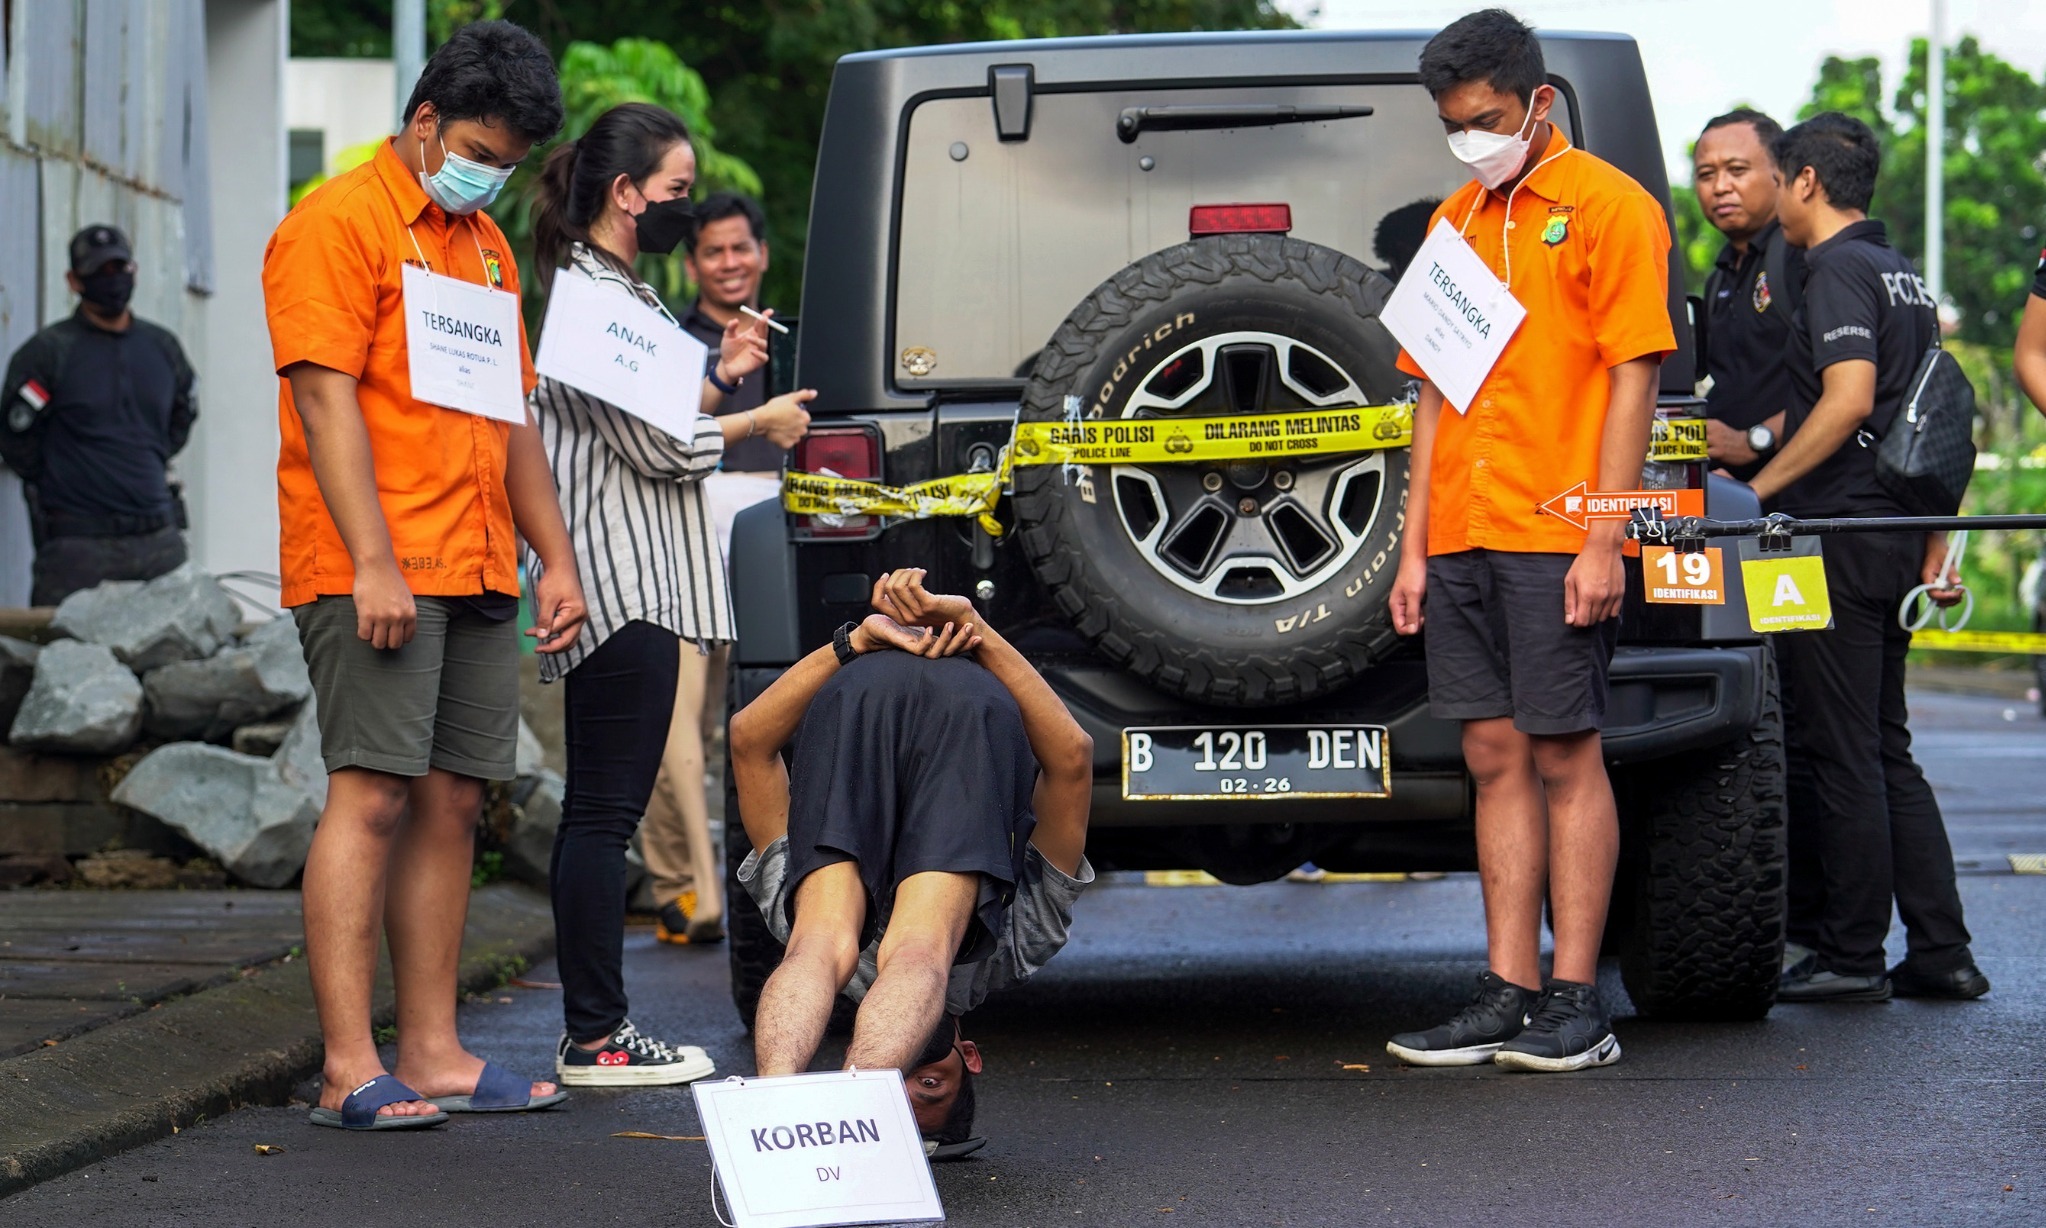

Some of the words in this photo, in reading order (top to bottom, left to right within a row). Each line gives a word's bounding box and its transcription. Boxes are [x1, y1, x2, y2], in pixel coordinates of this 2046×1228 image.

[1428, 261, 1492, 340] TERSANGKA
[422, 310, 503, 347] TERSANGKA
[606, 322, 657, 357] ANAK
[1823, 325, 1872, 343] RESERSE
[448, 348, 466, 359] LUKAS
[614, 354, 640, 373] A.G
[1050, 427, 1097, 445] GARIS
[1103, 425, 1155, 444] POLISI
[1204, 420, 1280, 440] DILARANG
[1285, 414, 1361, 438] MELINTAS
[1073, 447, 1107, 458] POLICE
[1110, 446, 1132, 458] LINE
[1249, 442, 1263, 453] DO
[1265, 440, 1283, 451] NOT
[1287, 438, 1319, 451] CROSS
[1681, 445, 1702, 454] LINE
[1587, 497, 1672, 513] IDENTIFIKASI
[1656, 551, 1711, 586] 19
[1653, 587, 1718, 600] IDENTIFIKASI
[1772, 574, 1806, 607] A
[1275, 603, 1332, 633] T/A
[1760, 614, 1821, 625] IDENTIFIKASI
[1130, 732, 1154, 773] B
[1193, 731, 1268, 771] 120
[1307, 730, 1381, 770] DEN
[750, 1118, 881, 1152] KORBAN
[816, 1166, 841, 1182] DV
